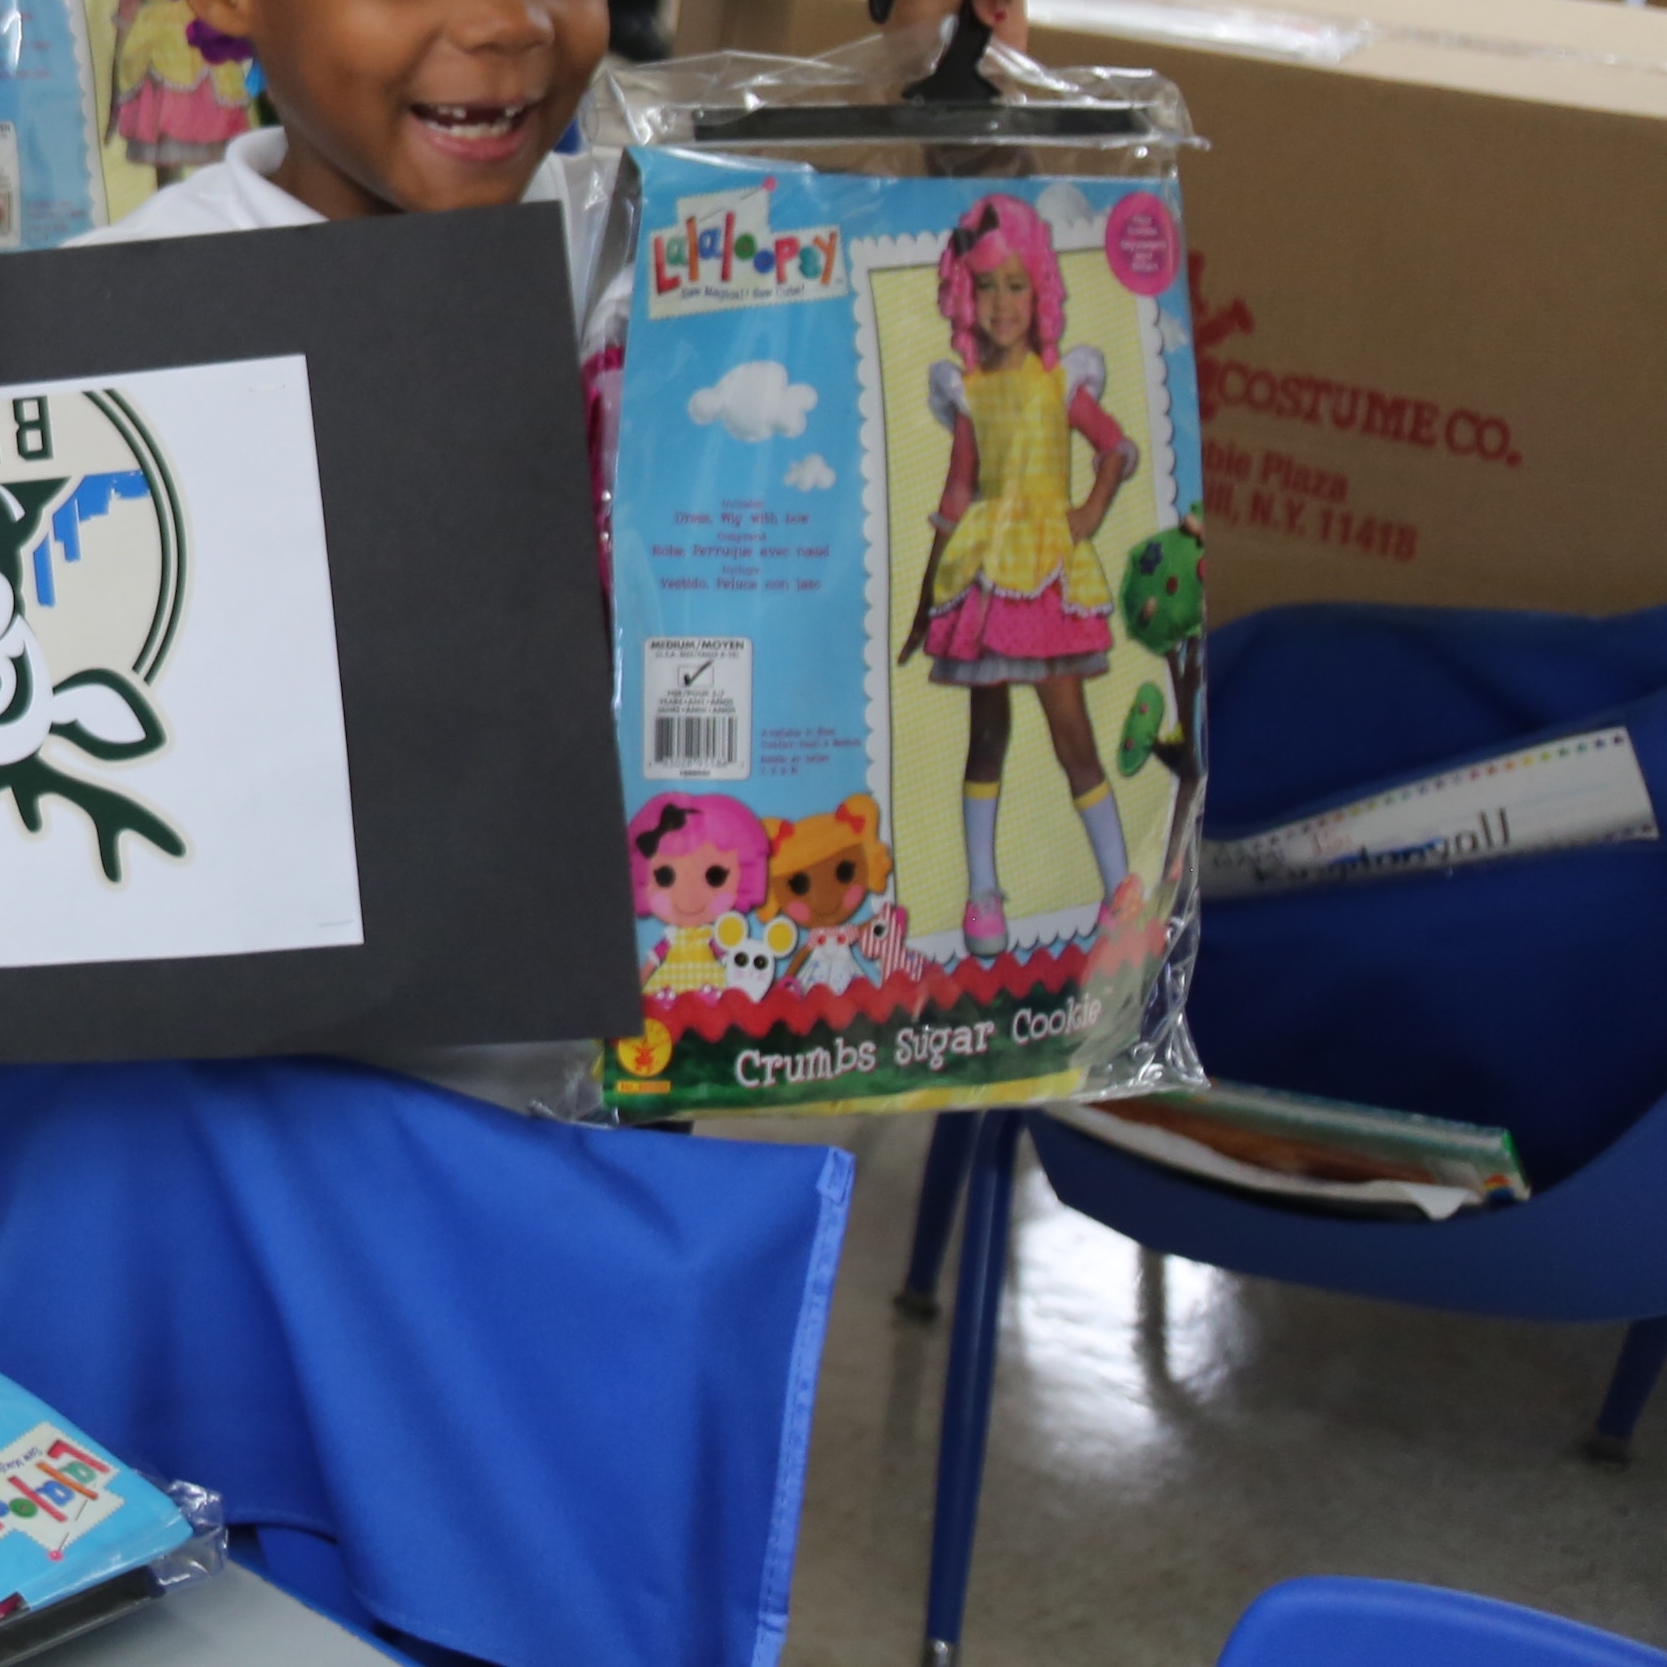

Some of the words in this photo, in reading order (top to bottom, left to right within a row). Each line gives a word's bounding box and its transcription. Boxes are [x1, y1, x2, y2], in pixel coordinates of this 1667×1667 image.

[1219, 361, 1439, 446] COSTUME
[1445, 408, 1523, 468] CO.
[735, 1038, 877, 1088] Crumbs
[895, 1019, 996, 1072] Sugar
[1013, 993, 1102, 1045] Cookie
